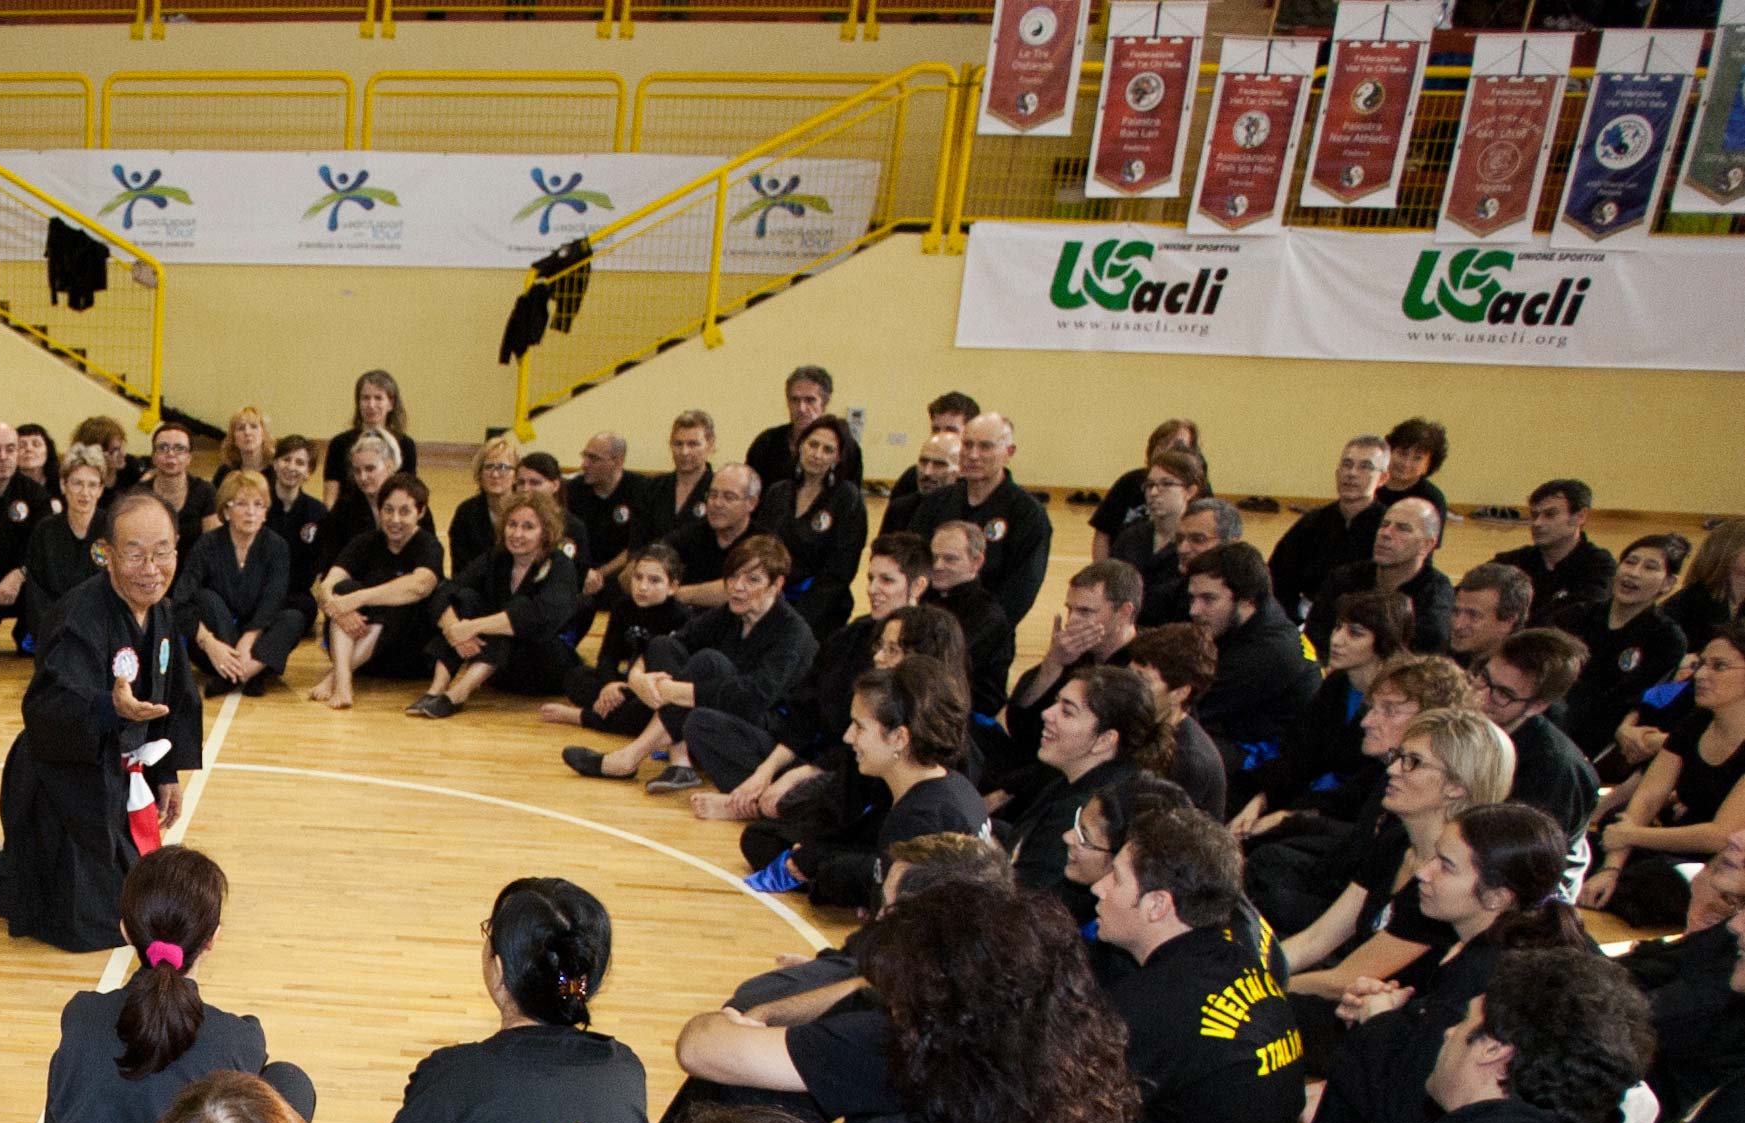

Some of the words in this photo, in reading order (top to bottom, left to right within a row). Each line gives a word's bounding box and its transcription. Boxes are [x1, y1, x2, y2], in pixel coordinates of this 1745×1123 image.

[1158, 243, 1193, 251] UNIONE
[1195, 243, 1240, 252] SPORTIVA
[1517, 252, 1555, 261] UNIONE
[1557, 253, 1606, 262] SPORTIVA
[1056, 319, 1209, 337] www.usacli.org
[1407, 331, 1568, 348] www.usacli.org
